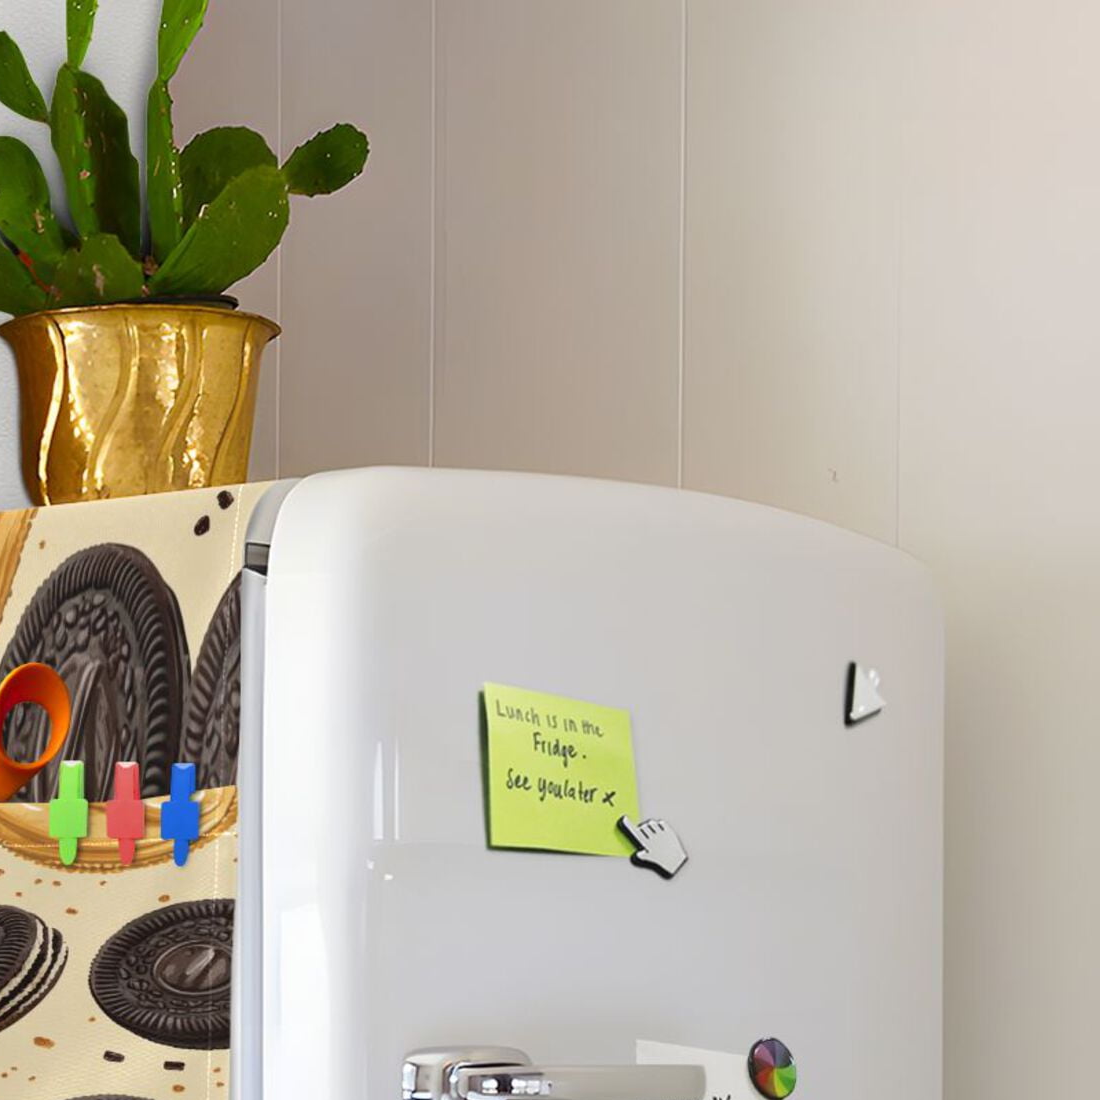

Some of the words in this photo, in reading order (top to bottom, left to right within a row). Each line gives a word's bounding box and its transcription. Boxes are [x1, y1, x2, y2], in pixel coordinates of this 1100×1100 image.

[495, 699, 540, 727] Lunch
[563, 718, 578, 733] in
[582, 720, 604, 738] the
[506, 767, 532, 791] See
